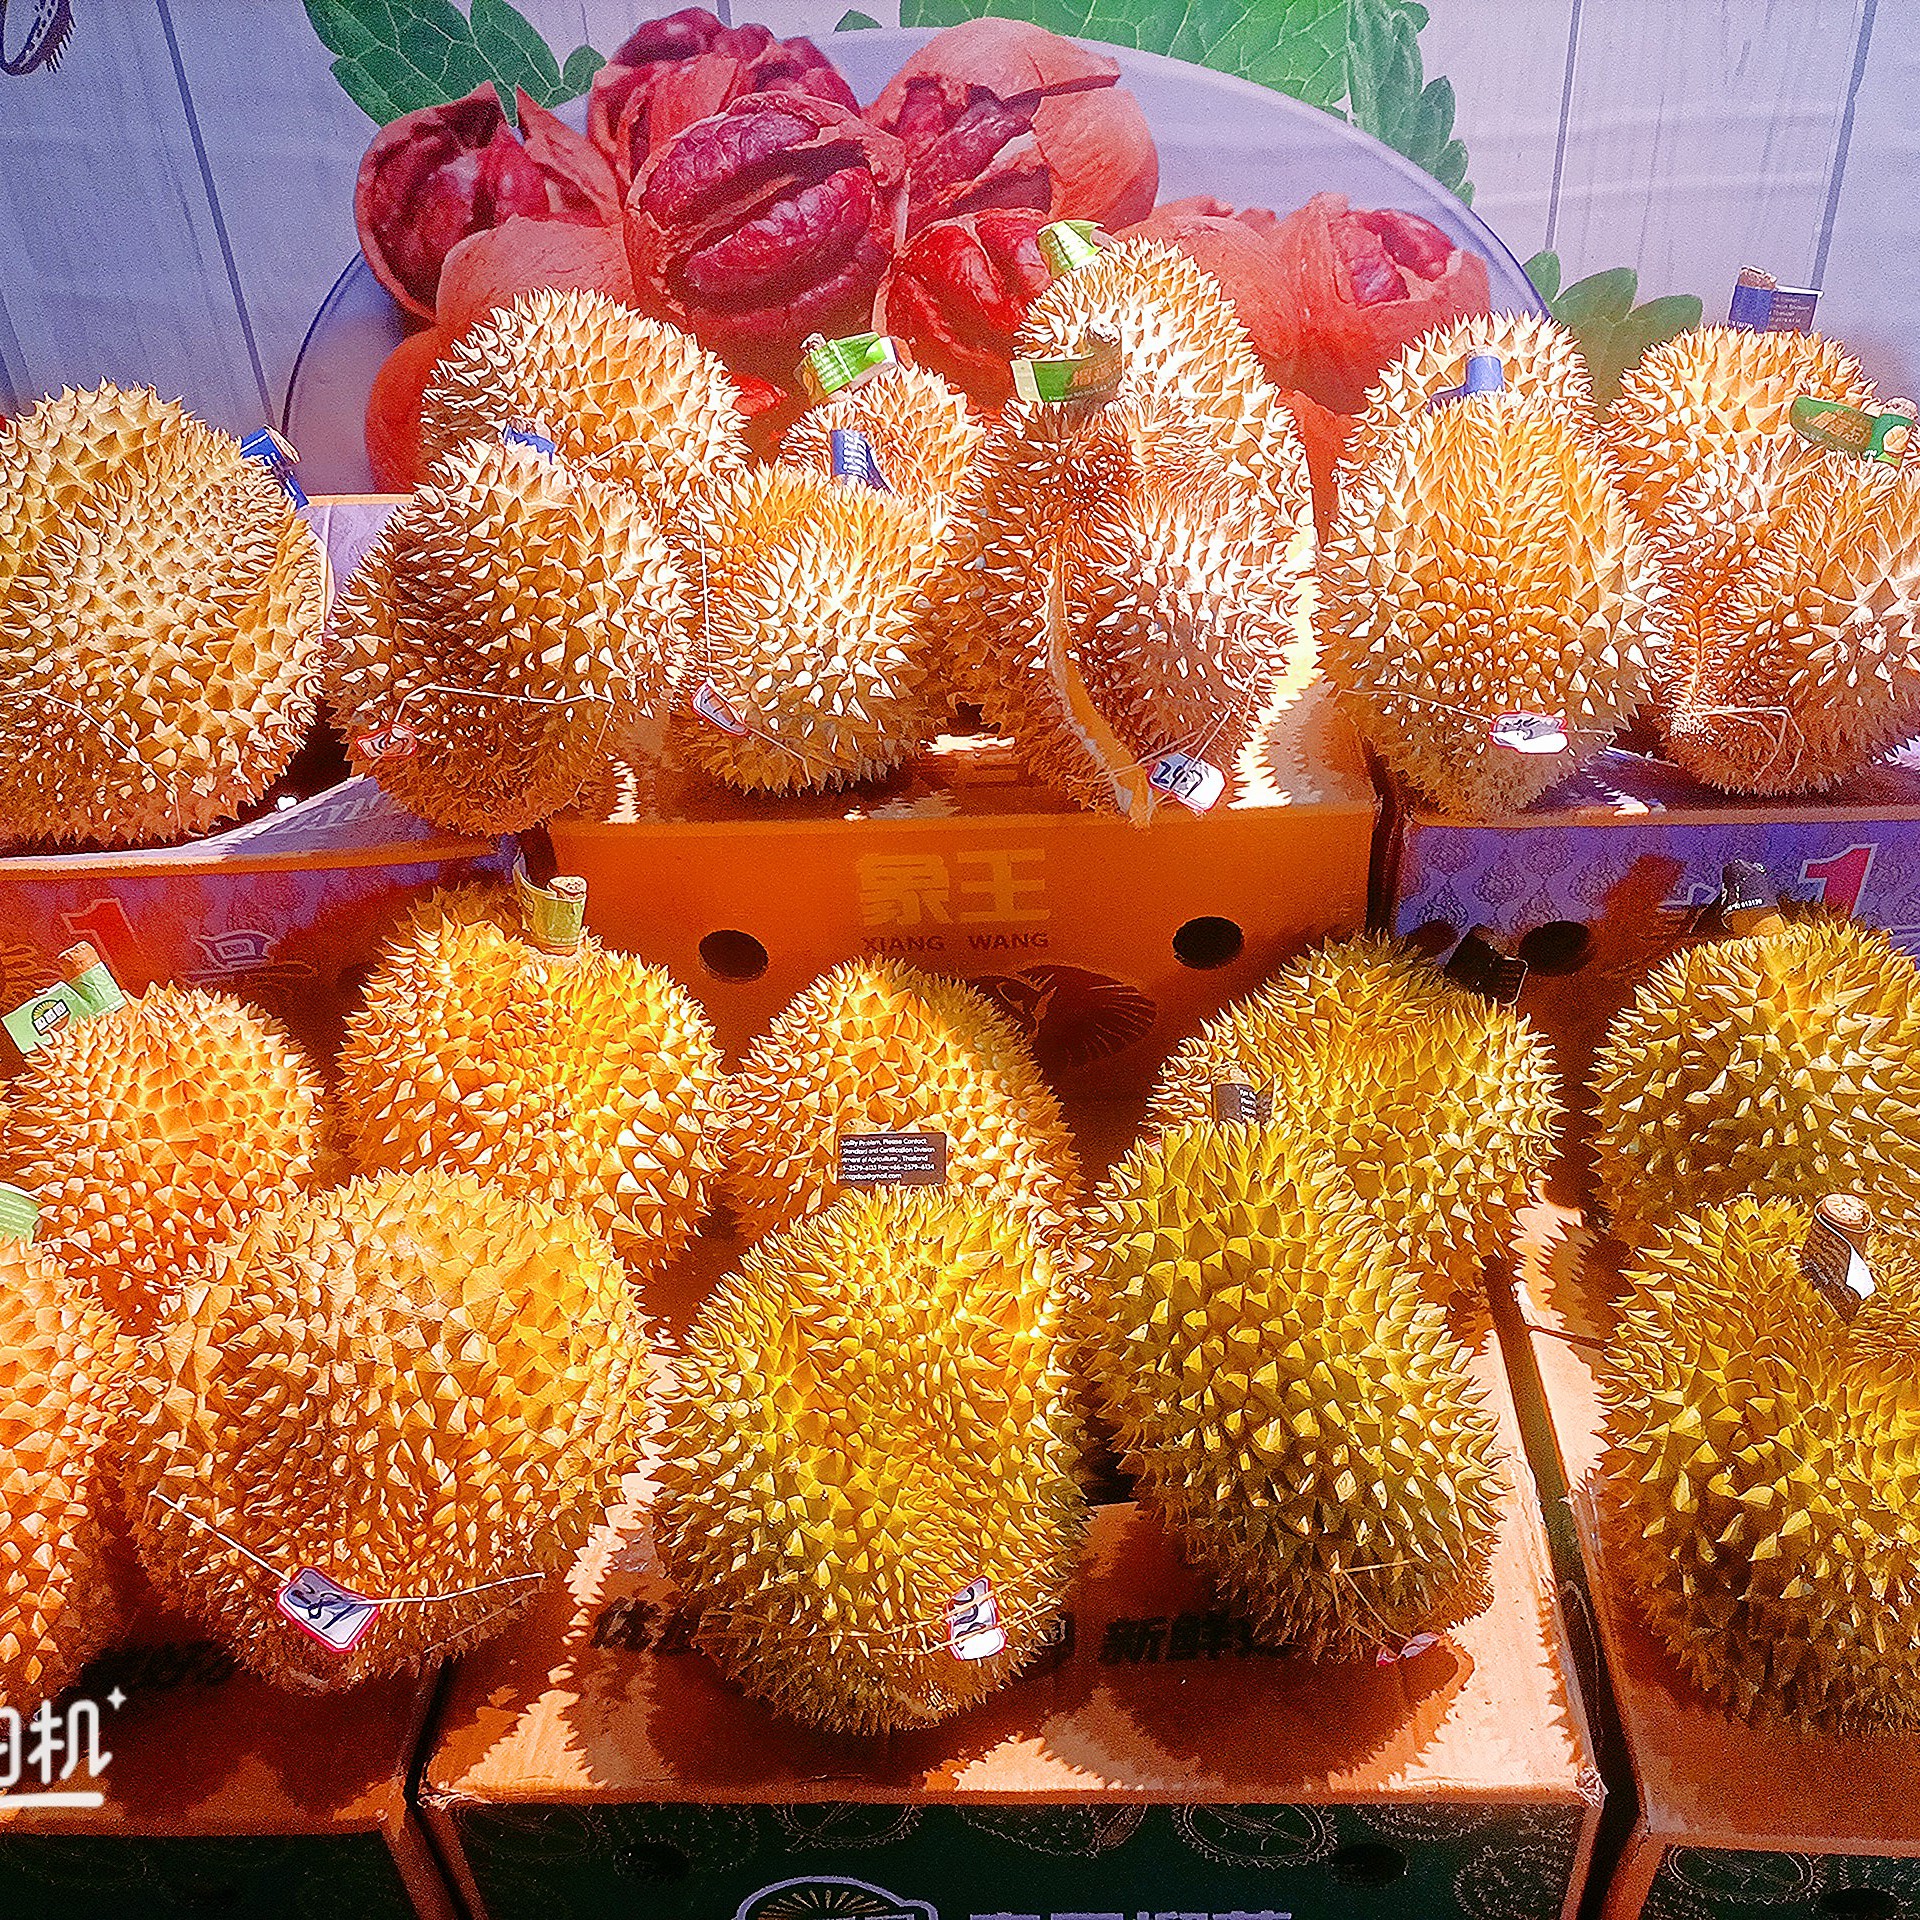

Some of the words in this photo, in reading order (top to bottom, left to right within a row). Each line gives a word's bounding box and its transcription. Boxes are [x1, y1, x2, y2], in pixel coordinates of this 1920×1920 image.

[857, 849, 1051, 927] 象王
[860, 935, 945, 952] XIANG
[966, 932, 1050, 950] WANG
[882, 1138, 903, 1146] Please
[903, 1137, 928, 1145] Contact
[843, 1147, 867, 1155] Standard
[879, 1146, 913, 1154] Certification
[902, 1154, 928, 1162] Thailand
